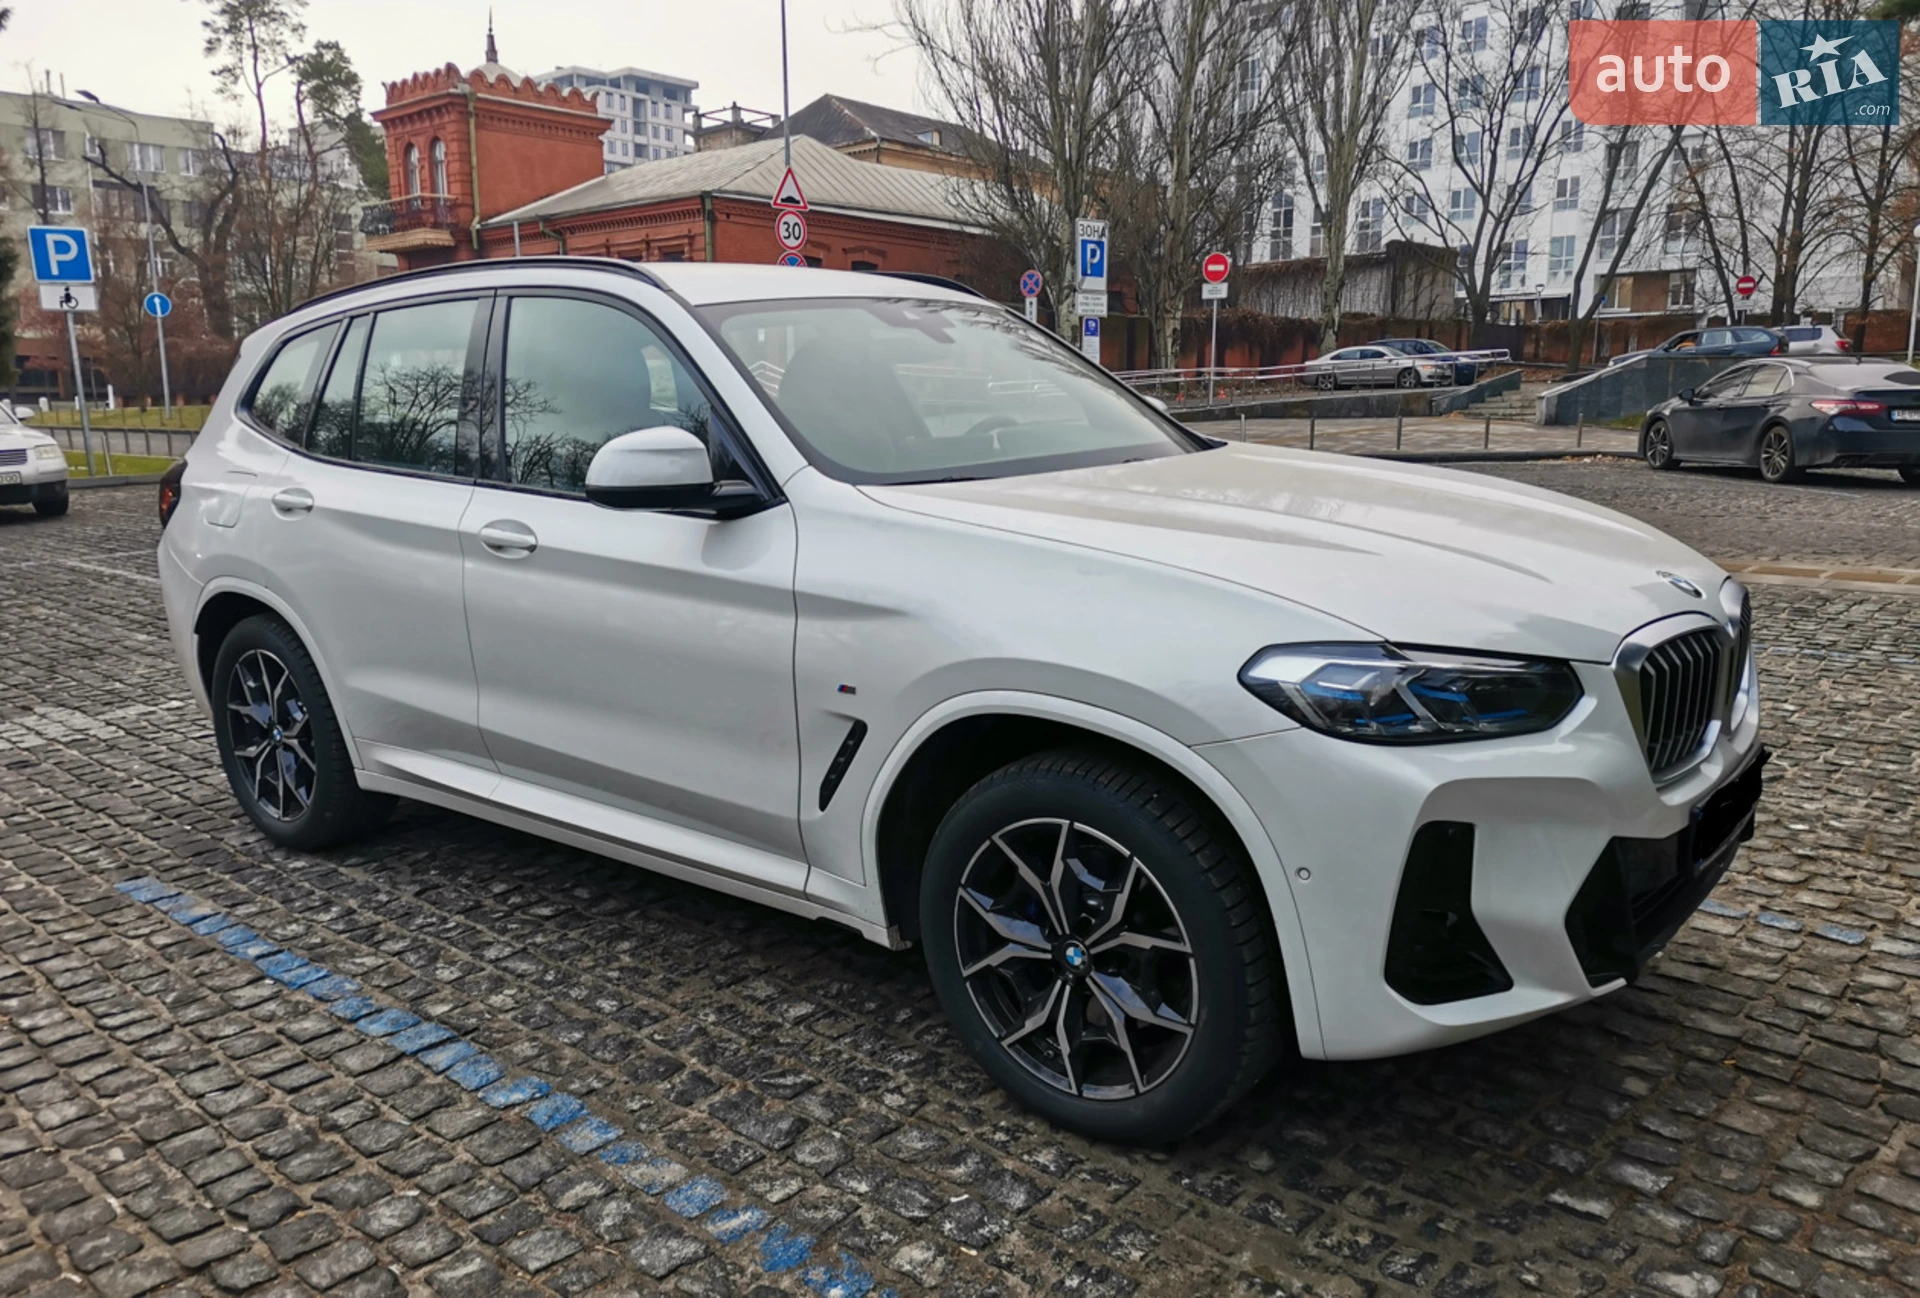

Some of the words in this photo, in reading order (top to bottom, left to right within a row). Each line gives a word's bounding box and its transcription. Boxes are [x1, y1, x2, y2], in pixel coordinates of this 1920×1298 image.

[782, 221, 802, 241] 30
[1079, 223, 1107, 239] ЗОНА
[45, 233, 79, 276] P
[1087, 243, 1101, 275] P
